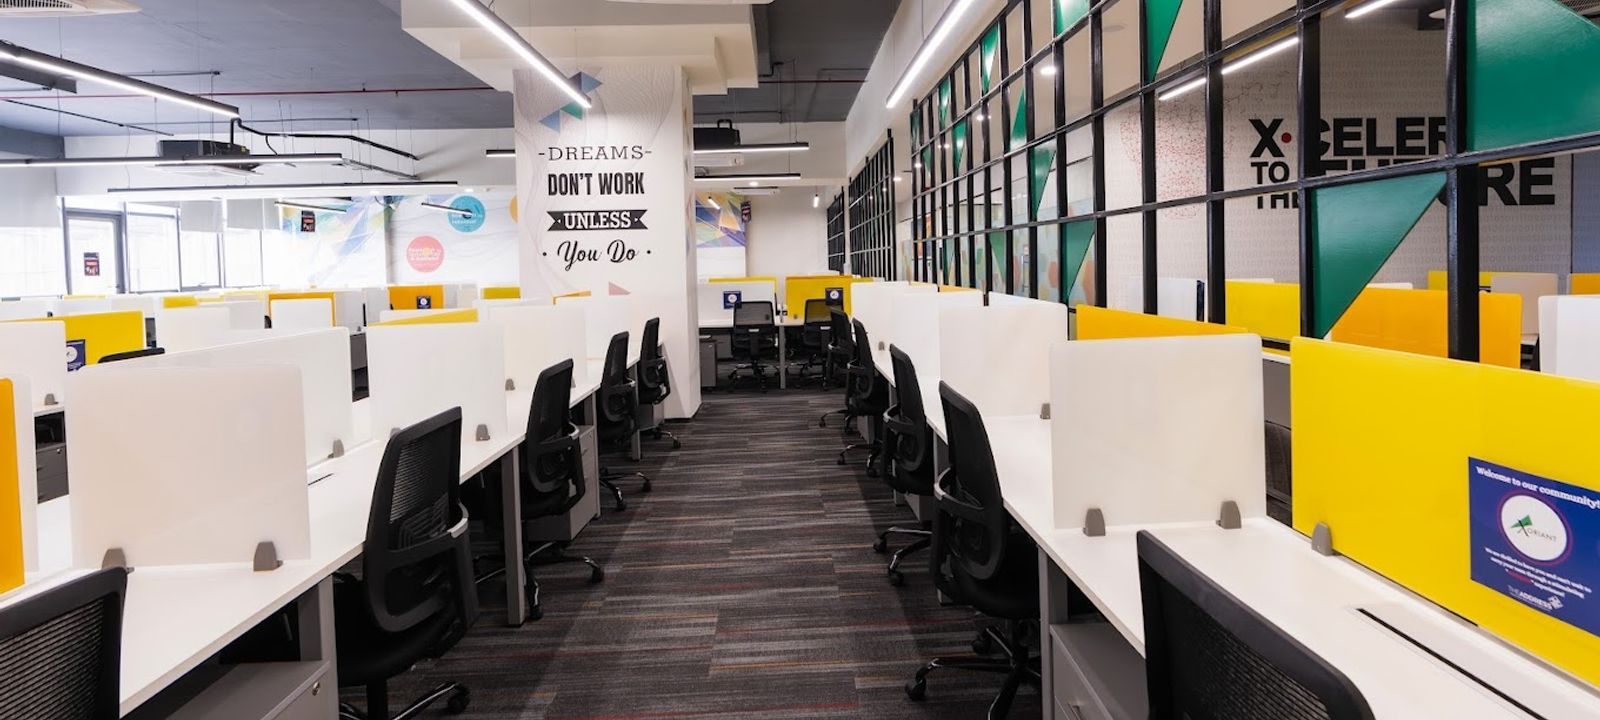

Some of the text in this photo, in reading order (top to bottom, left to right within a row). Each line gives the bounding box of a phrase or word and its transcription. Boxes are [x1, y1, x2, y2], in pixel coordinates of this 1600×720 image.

[548, 172, 644, 195] DON'T WORK
[1250, 161, 1290, 184] TO
[563, 210, 632, 229] UNLESS
[557, 239, 639, 271] You Do
[1476, 466, 1511, 484] Welcome
[1512, 477, 1521, 487] to
[1522, 482, 1538, 491] our
